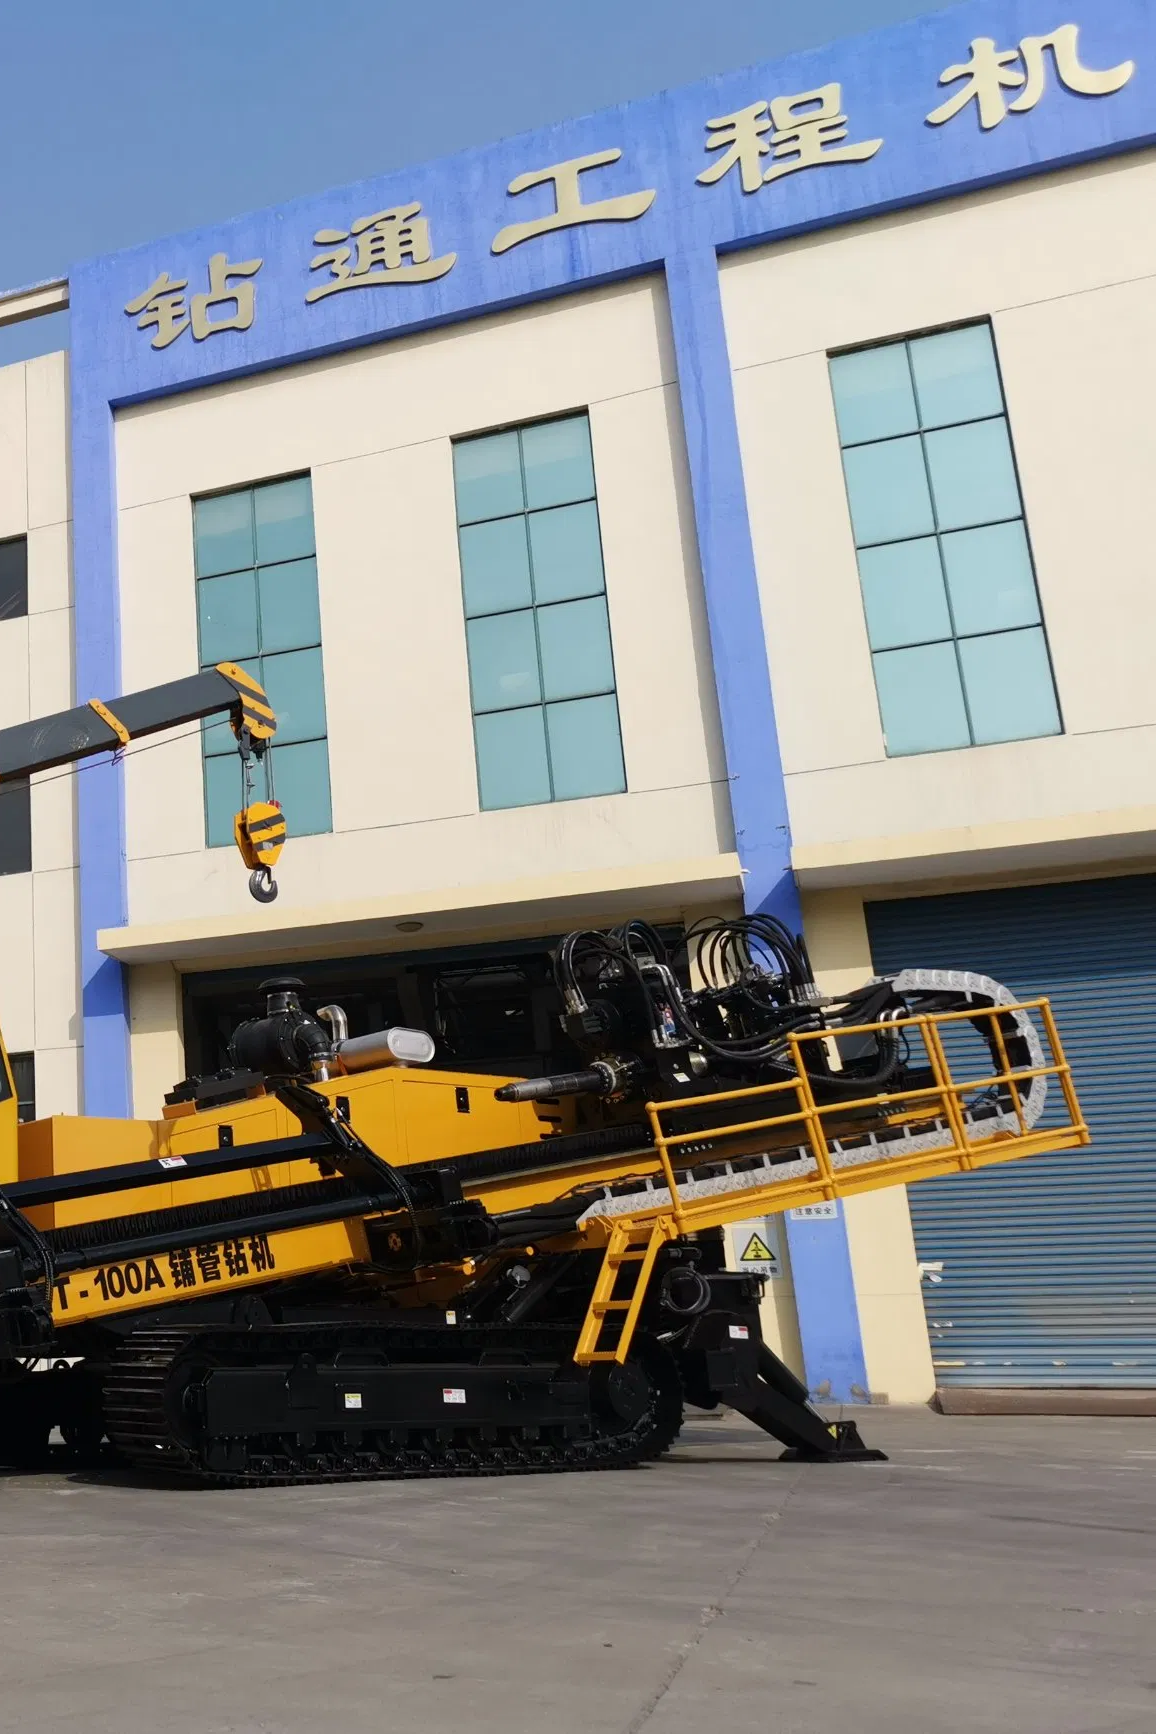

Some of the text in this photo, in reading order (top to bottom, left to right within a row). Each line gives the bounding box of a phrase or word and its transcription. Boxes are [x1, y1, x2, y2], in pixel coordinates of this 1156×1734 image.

[124, 23, 1135, 350] 钻通工程机
[795, 1206, 832, 1216] 注意安全
